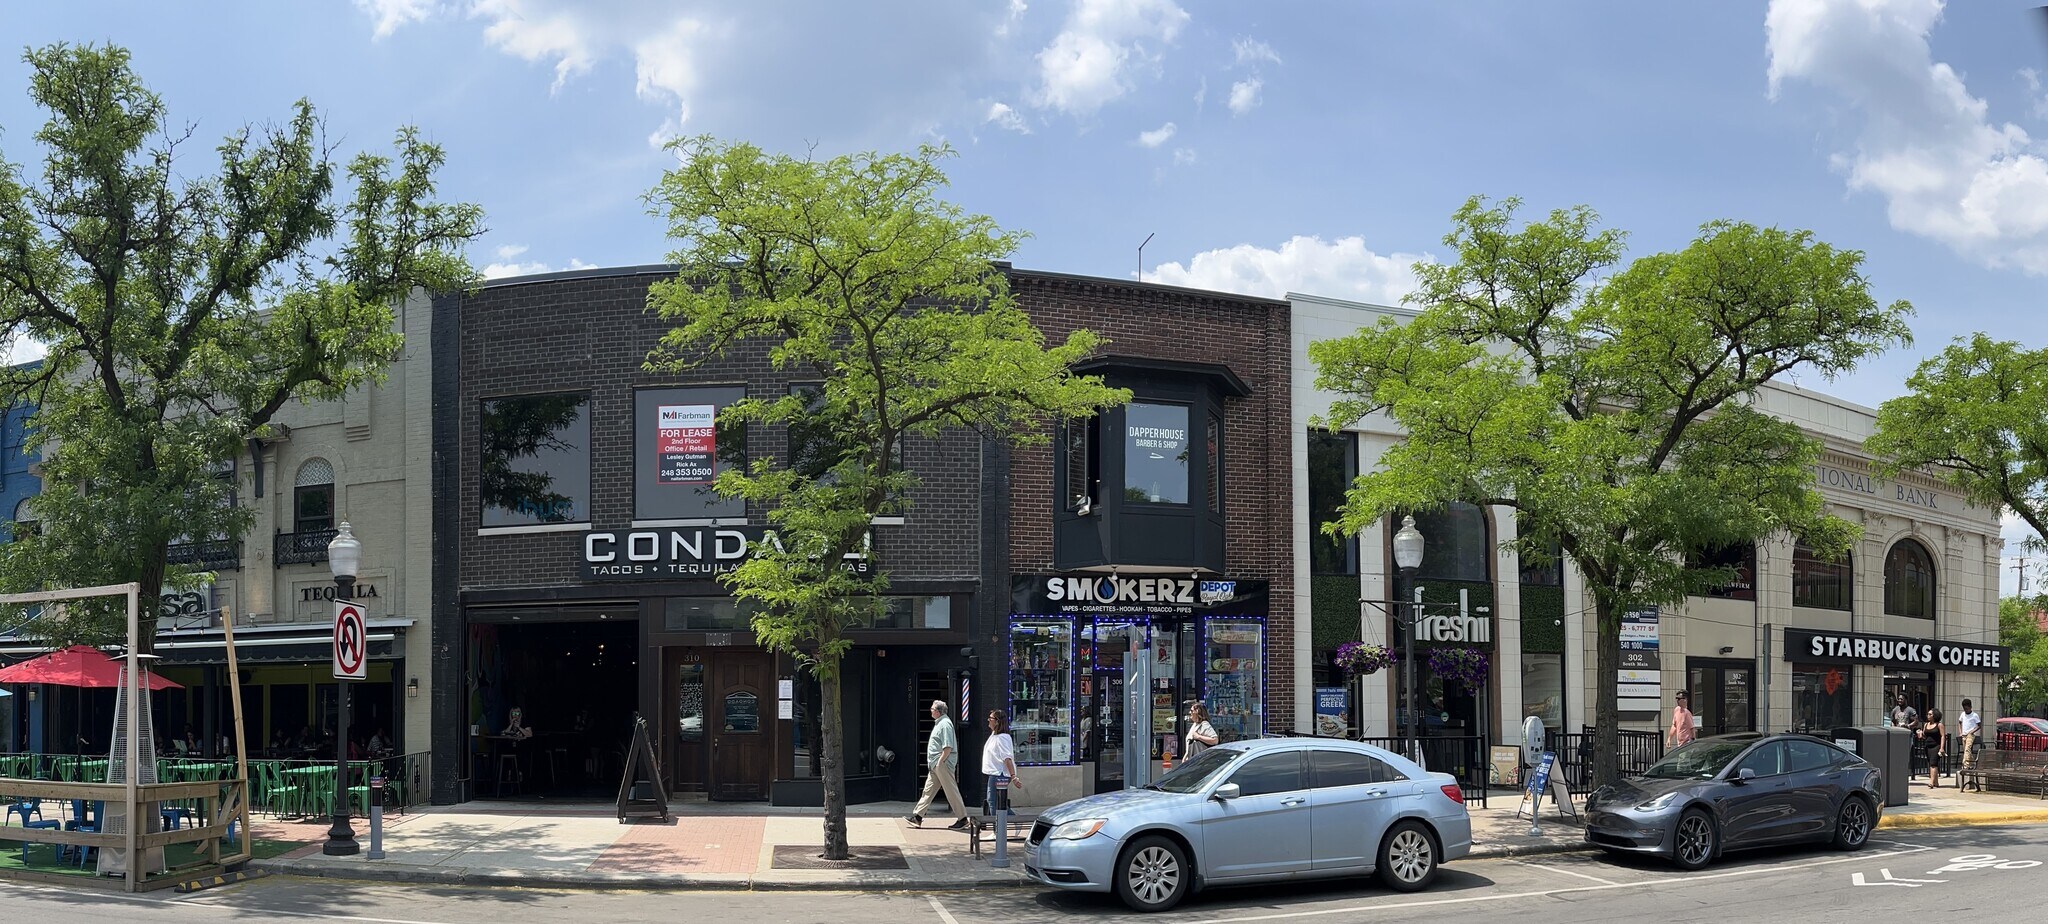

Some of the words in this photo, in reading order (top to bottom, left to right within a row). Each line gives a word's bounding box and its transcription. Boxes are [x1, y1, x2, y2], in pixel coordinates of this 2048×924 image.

[662, 411, 677, 419] NAI
[660, 430, 680, 438] FOR
[683, 429, 712, 437] LEASE
[1136, 439, 1157, 448] BARBER
[1163, 441, 1178, 449] SHOP
[1809, 464, 1875, 494] TIONAL
[1896, 484, 1938, 508] BANK
[591, 565, 644, 575] TACOS
[301, 585, 378, 602] TEQILA
[1046, 576, 1194, 604] SMOKERZ
[1200, 581, 1236, 592] DEPOT
[1412, 586, 1490, 642] freshii
[1812, 636, 1932, 662] STARBUCKS
[1939, 646, 2000, 668] COFFEE
